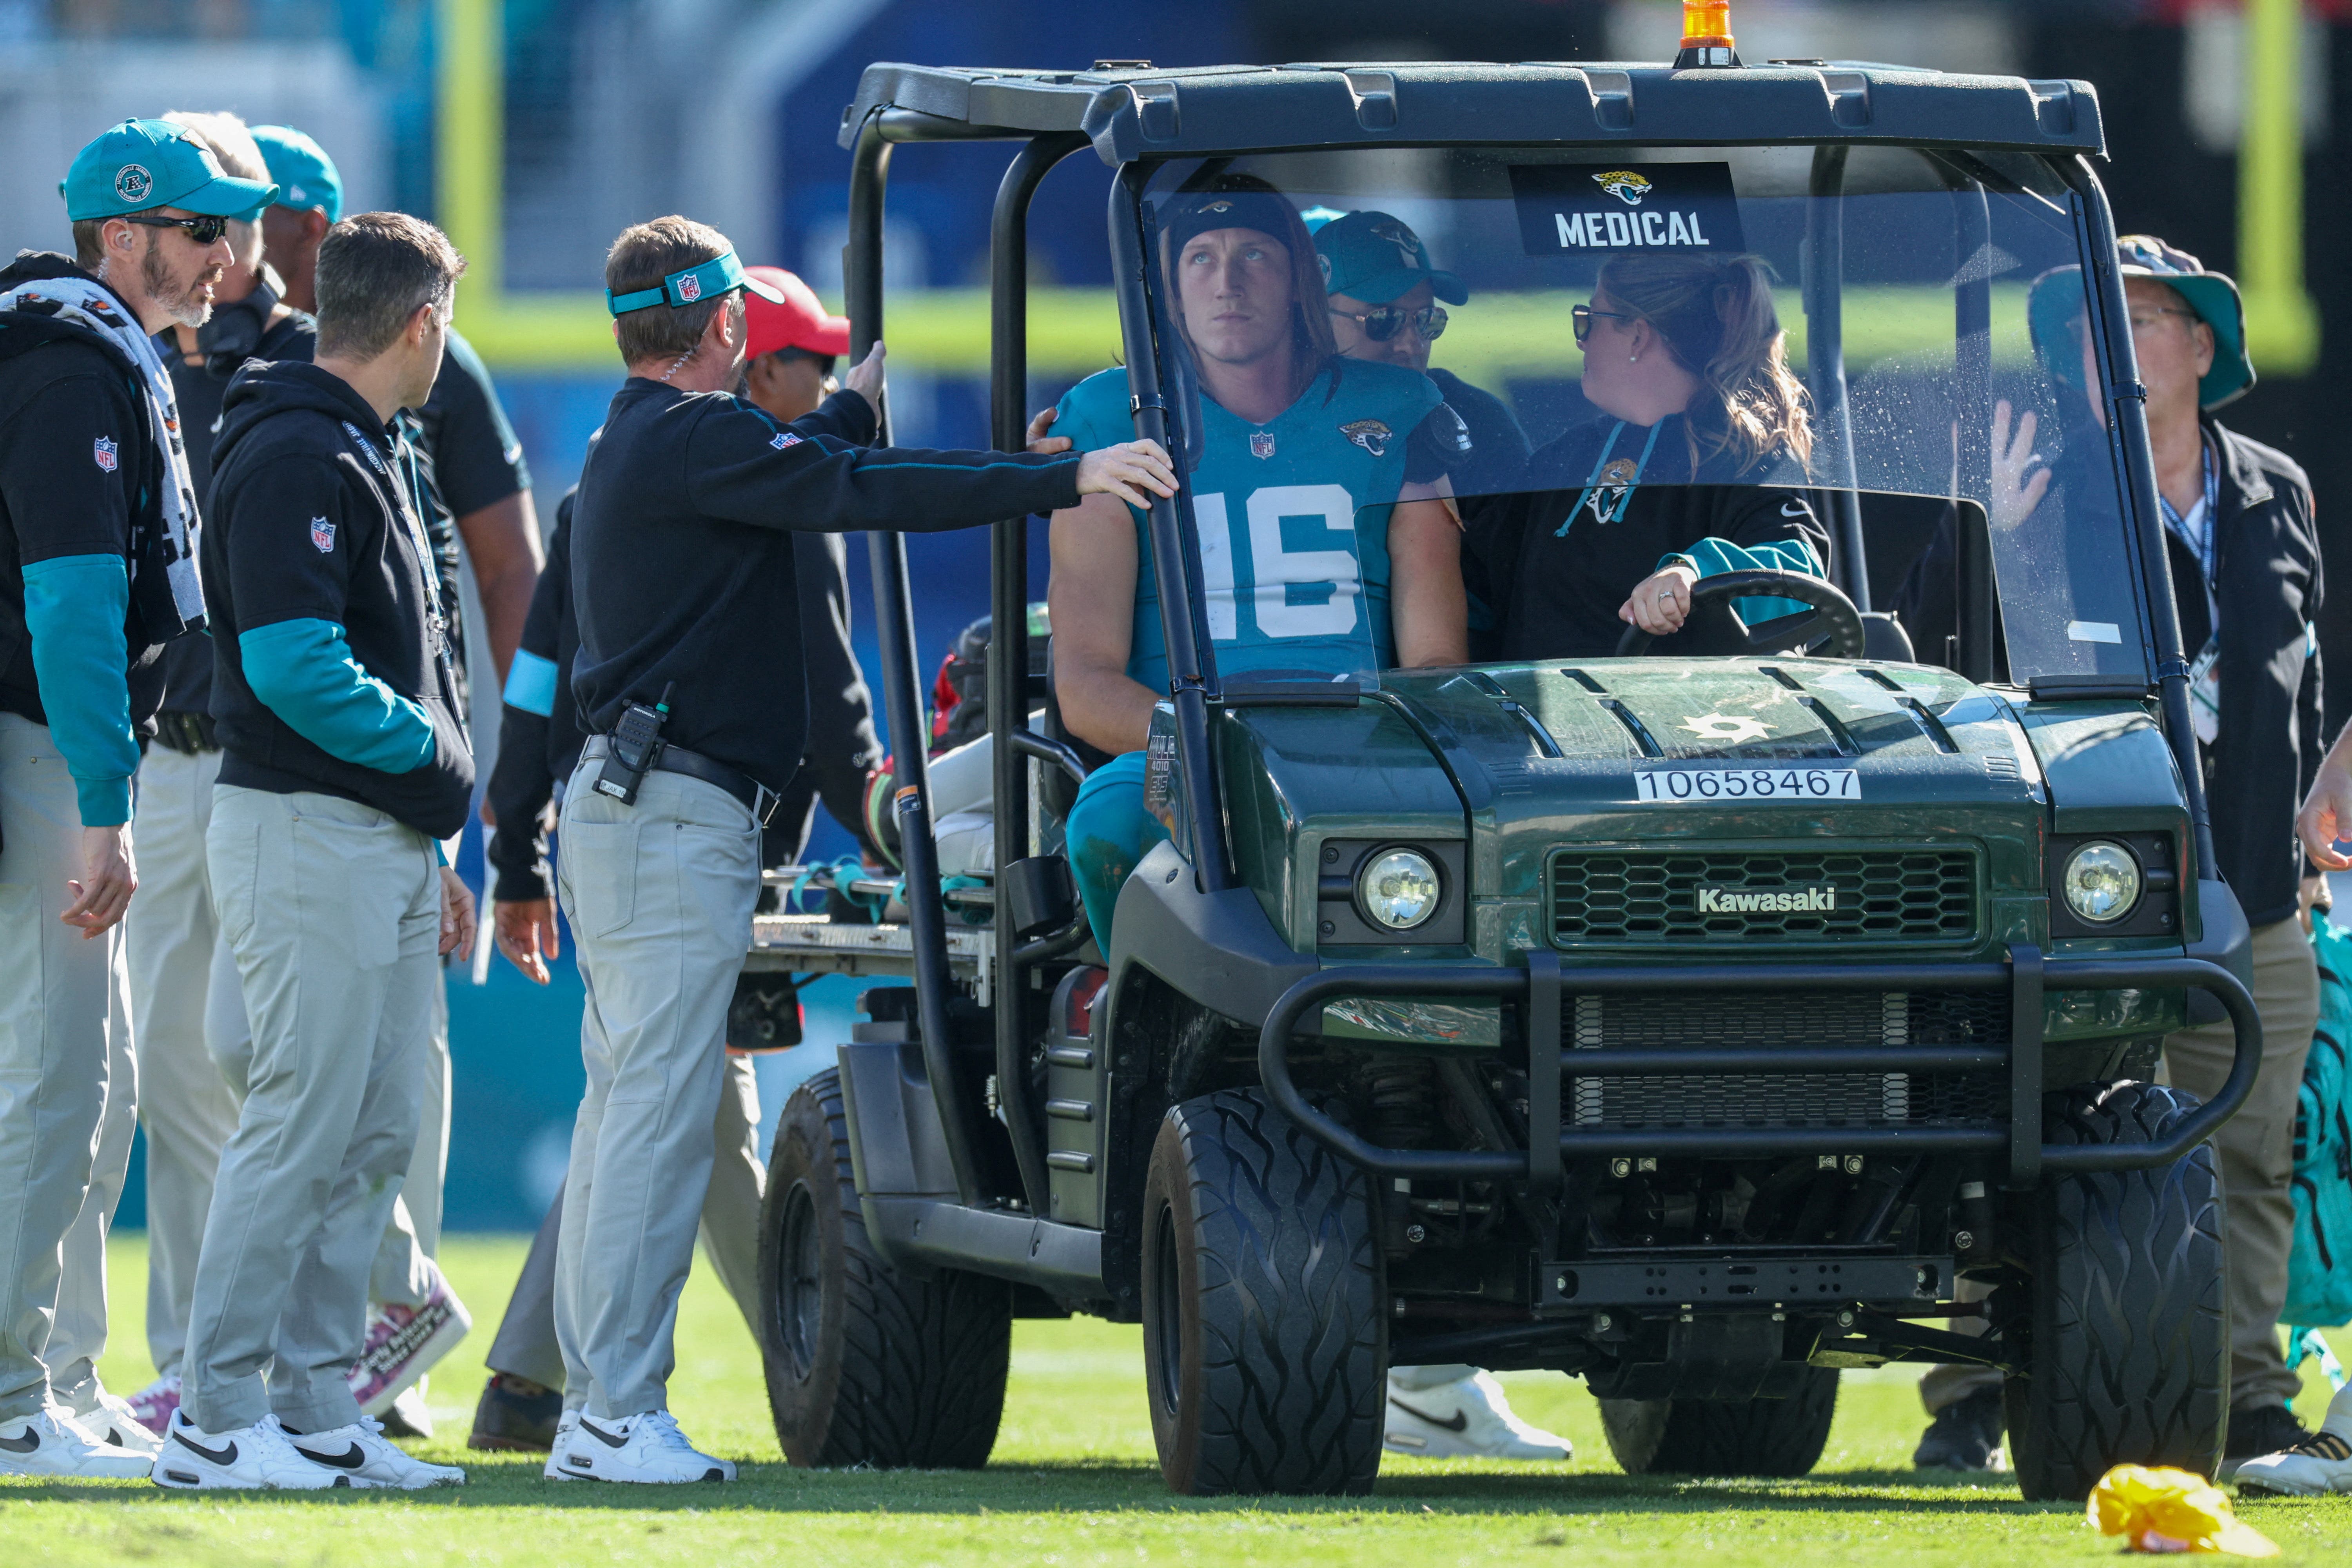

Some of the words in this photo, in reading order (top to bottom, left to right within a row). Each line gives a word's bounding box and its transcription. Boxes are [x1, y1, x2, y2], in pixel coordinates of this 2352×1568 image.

[1555, 211, 1710, 247] MEDICAL
[683, 285, 699, 298] NFL
[356, 438, 387, 475] JACKSONVILLE
[1256, 443, 1271, 454] NFL
[97, 450, 114, 467] NFL
[314, 530, 330, 548] NFL
[1193, 484, 1361, 640] 16
[633, 707, 655, 719] MOTOROLA
[1147, 735, 1176, 760] MULE
[1151, 760, 1169, 771] 4010
[606, 785, 617, 793] JAX
[1641, 769, 1853, 799] 10658467
[1699, 887, 1835, 912] Kawasaki
